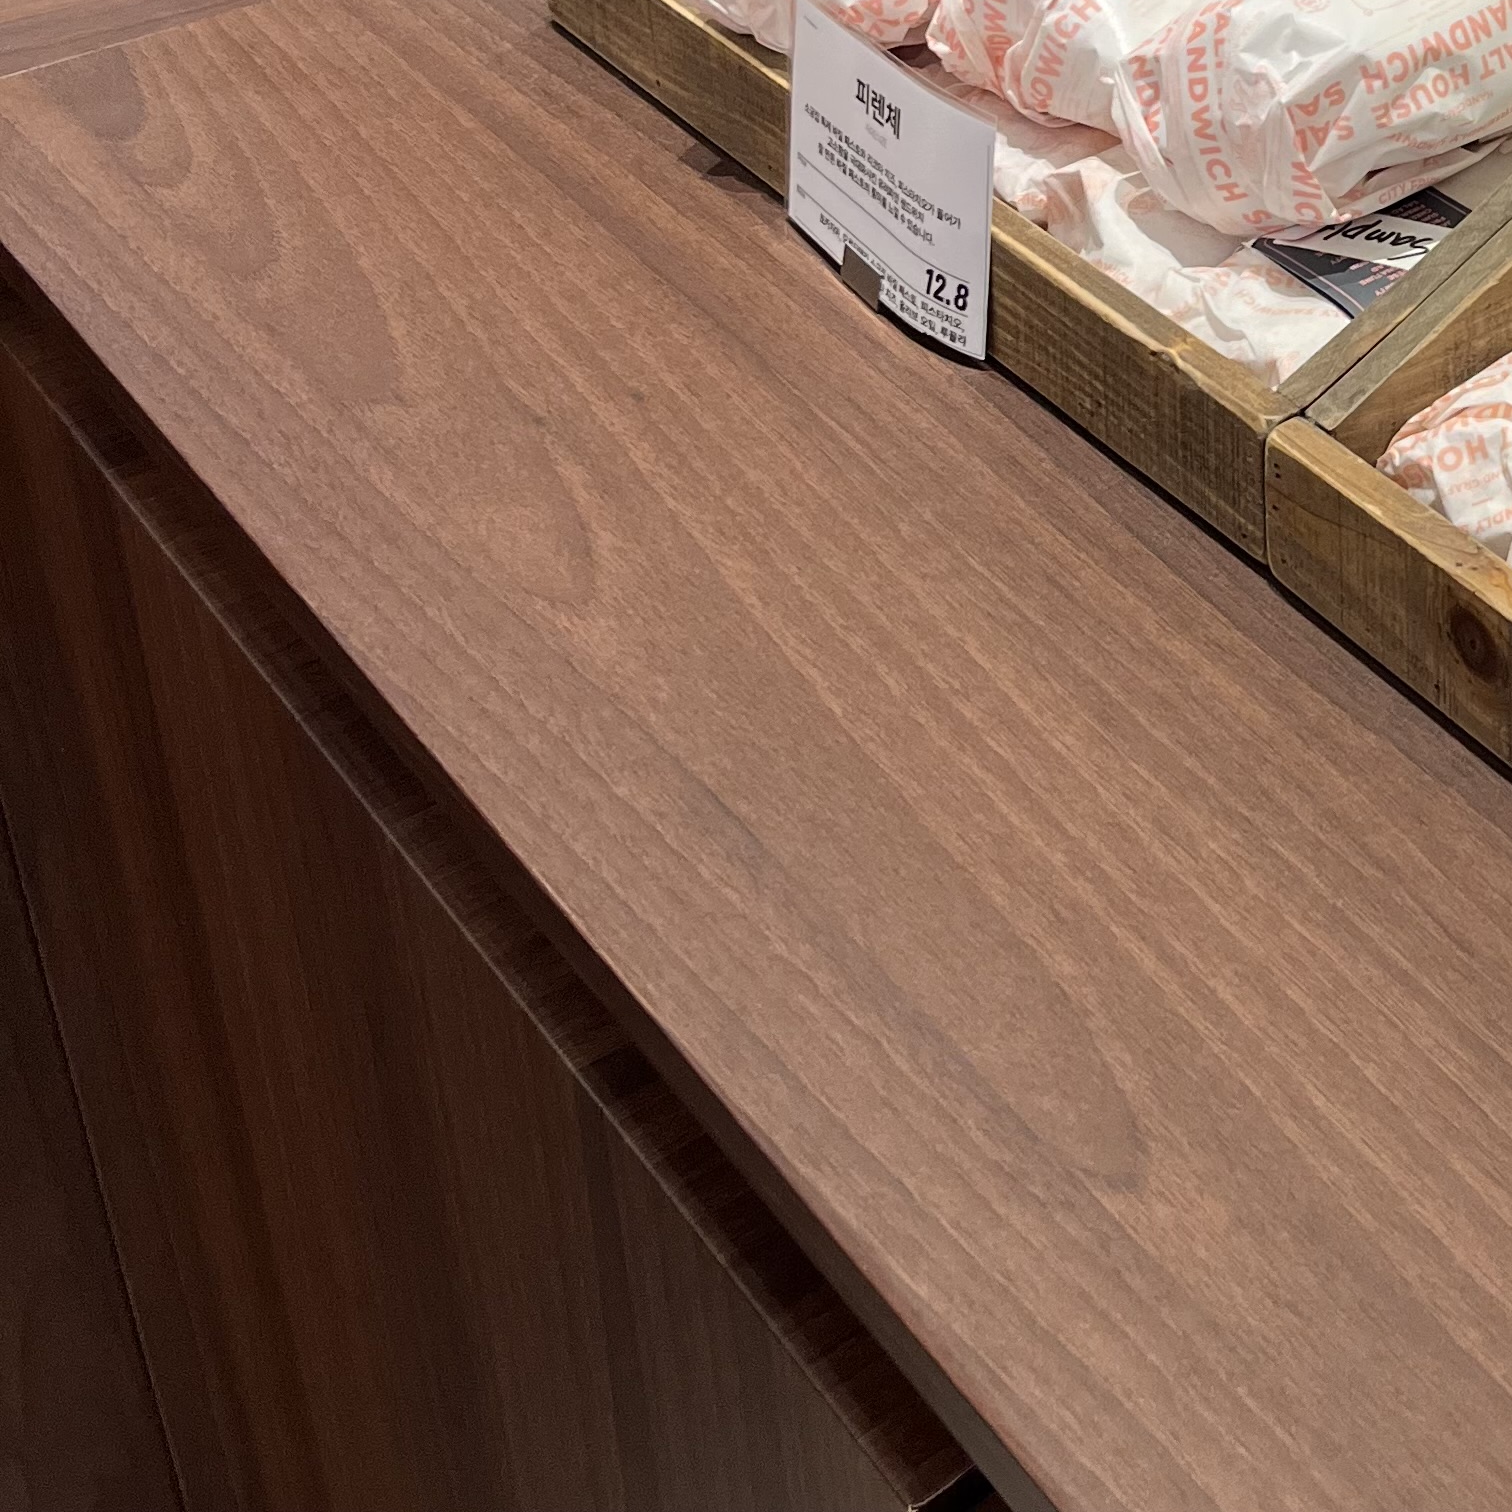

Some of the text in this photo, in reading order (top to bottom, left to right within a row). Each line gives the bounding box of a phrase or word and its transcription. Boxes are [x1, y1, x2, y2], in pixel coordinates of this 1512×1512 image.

[855, 77, 901, 140] 피렌체
[1371, 64, 1470, 129] HOUSE
[924, 268, 969, 312] 12.8
